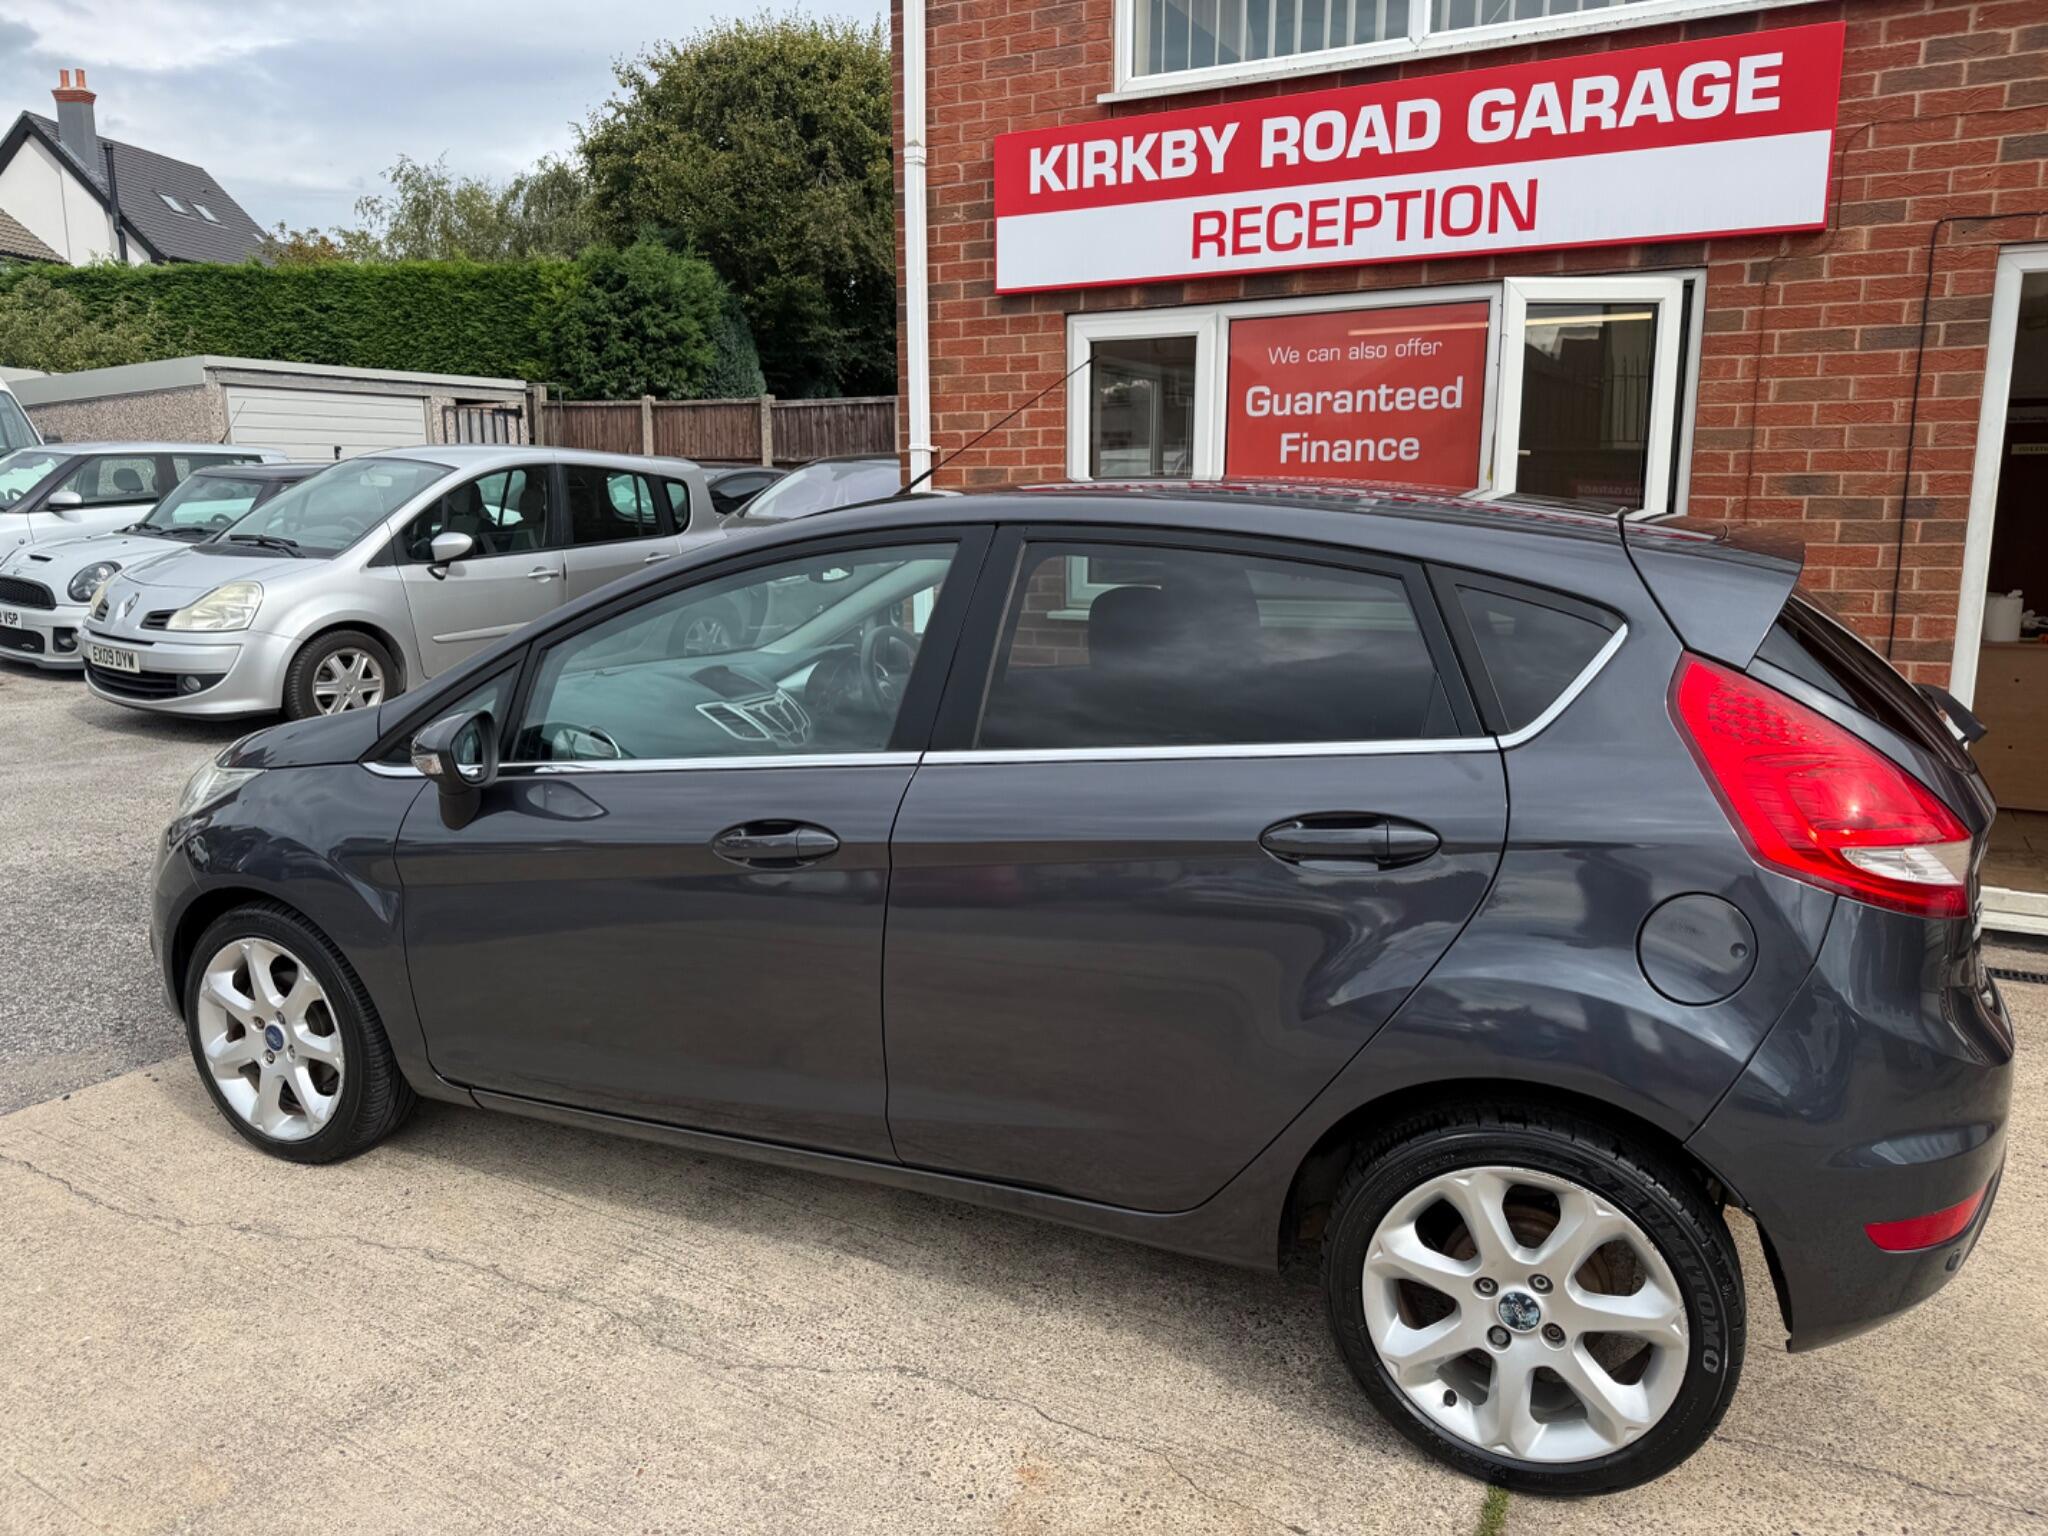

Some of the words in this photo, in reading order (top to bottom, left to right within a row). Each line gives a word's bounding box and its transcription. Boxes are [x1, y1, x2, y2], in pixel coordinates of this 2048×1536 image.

[1029, 123, 1240, 195] KIRKBY
[1260, 99, 1441, 169] ROAD
[1467, 51, 1783, 144] GARAGE
[1192, 179, 1538, 259] RECEPTION
[1268, 346, 1300, 365] We
[1306, 348, 1341, 363] can
[1348, 341, 1388, 360] also
[1394, 337, 1443, 358] offer
[1245, 375, 1464, 417] Guaranteed
[1280, 432, 1420, 464] Finance
[3, 610, 18, 625] VSP
[93, 646, 114, 666] EX09
[115, 650, 134, 669] DYW
